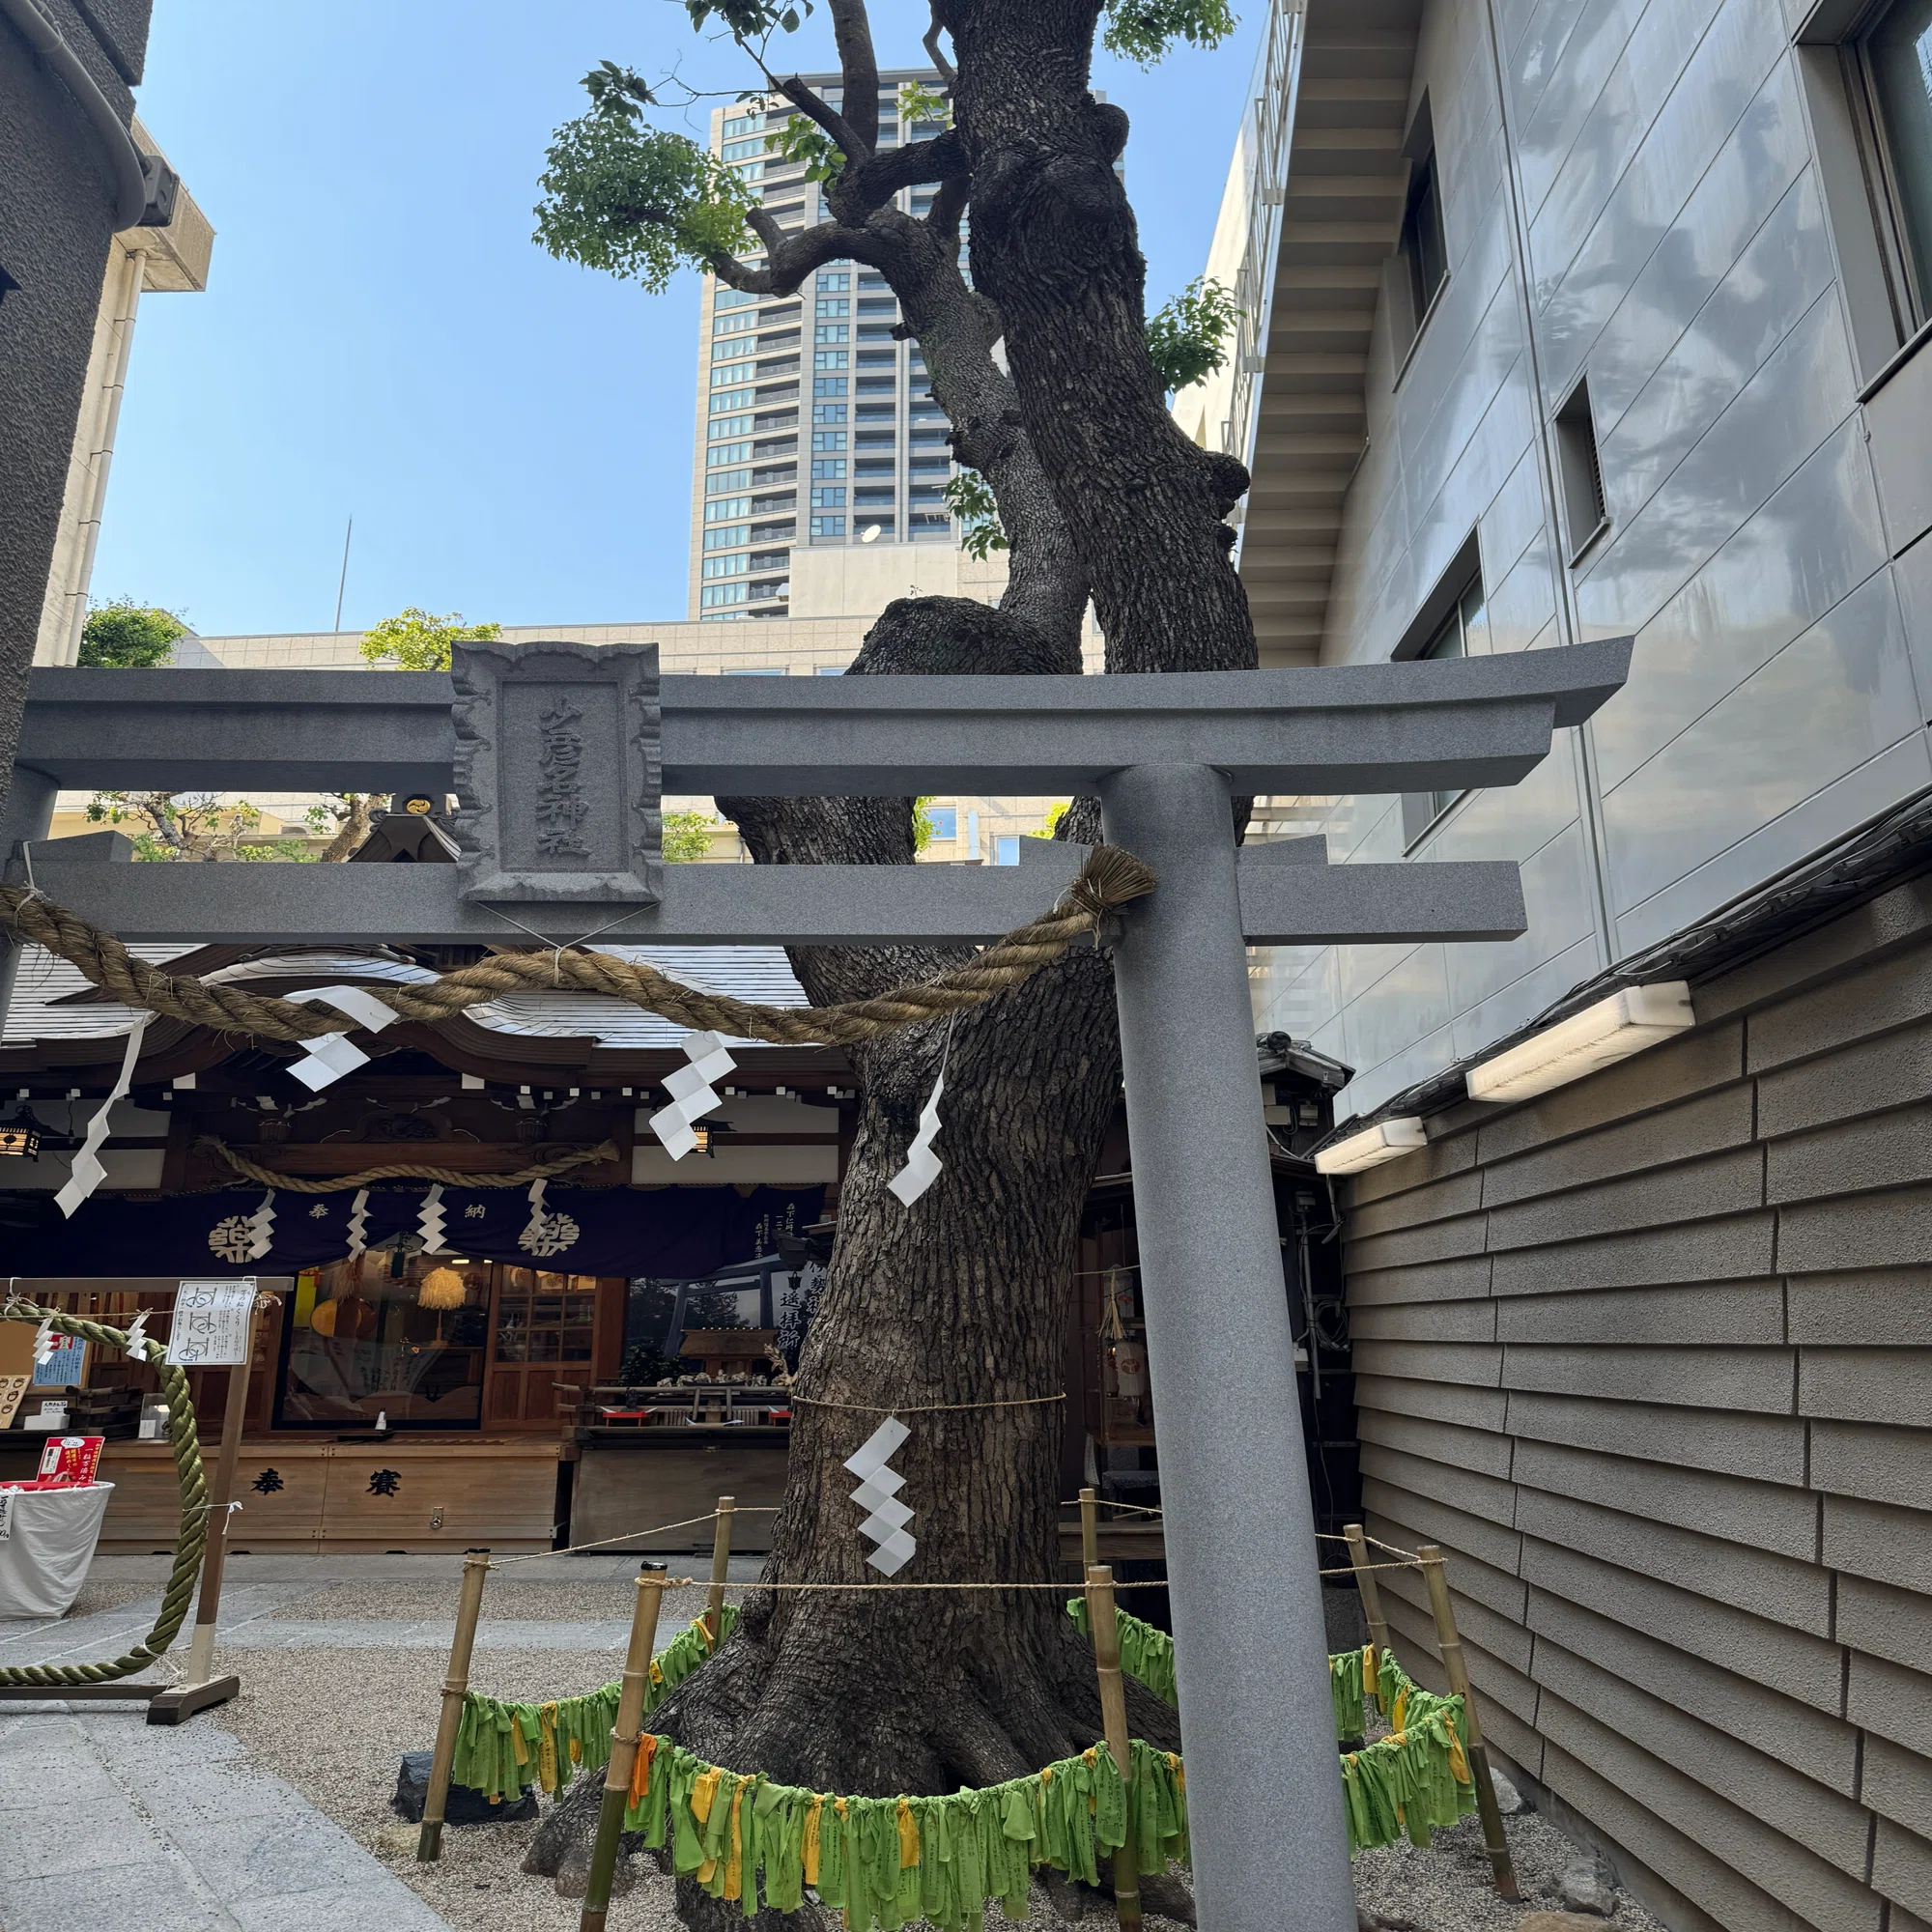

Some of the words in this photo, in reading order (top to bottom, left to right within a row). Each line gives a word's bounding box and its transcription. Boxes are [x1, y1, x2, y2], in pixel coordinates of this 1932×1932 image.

[308, 1203, 329, 1219] 奉
[464, 1204, 486, 1219] 納
[251, 1467, 285, 1496] 奉
[365, 1467, 401, 1497] 賽
